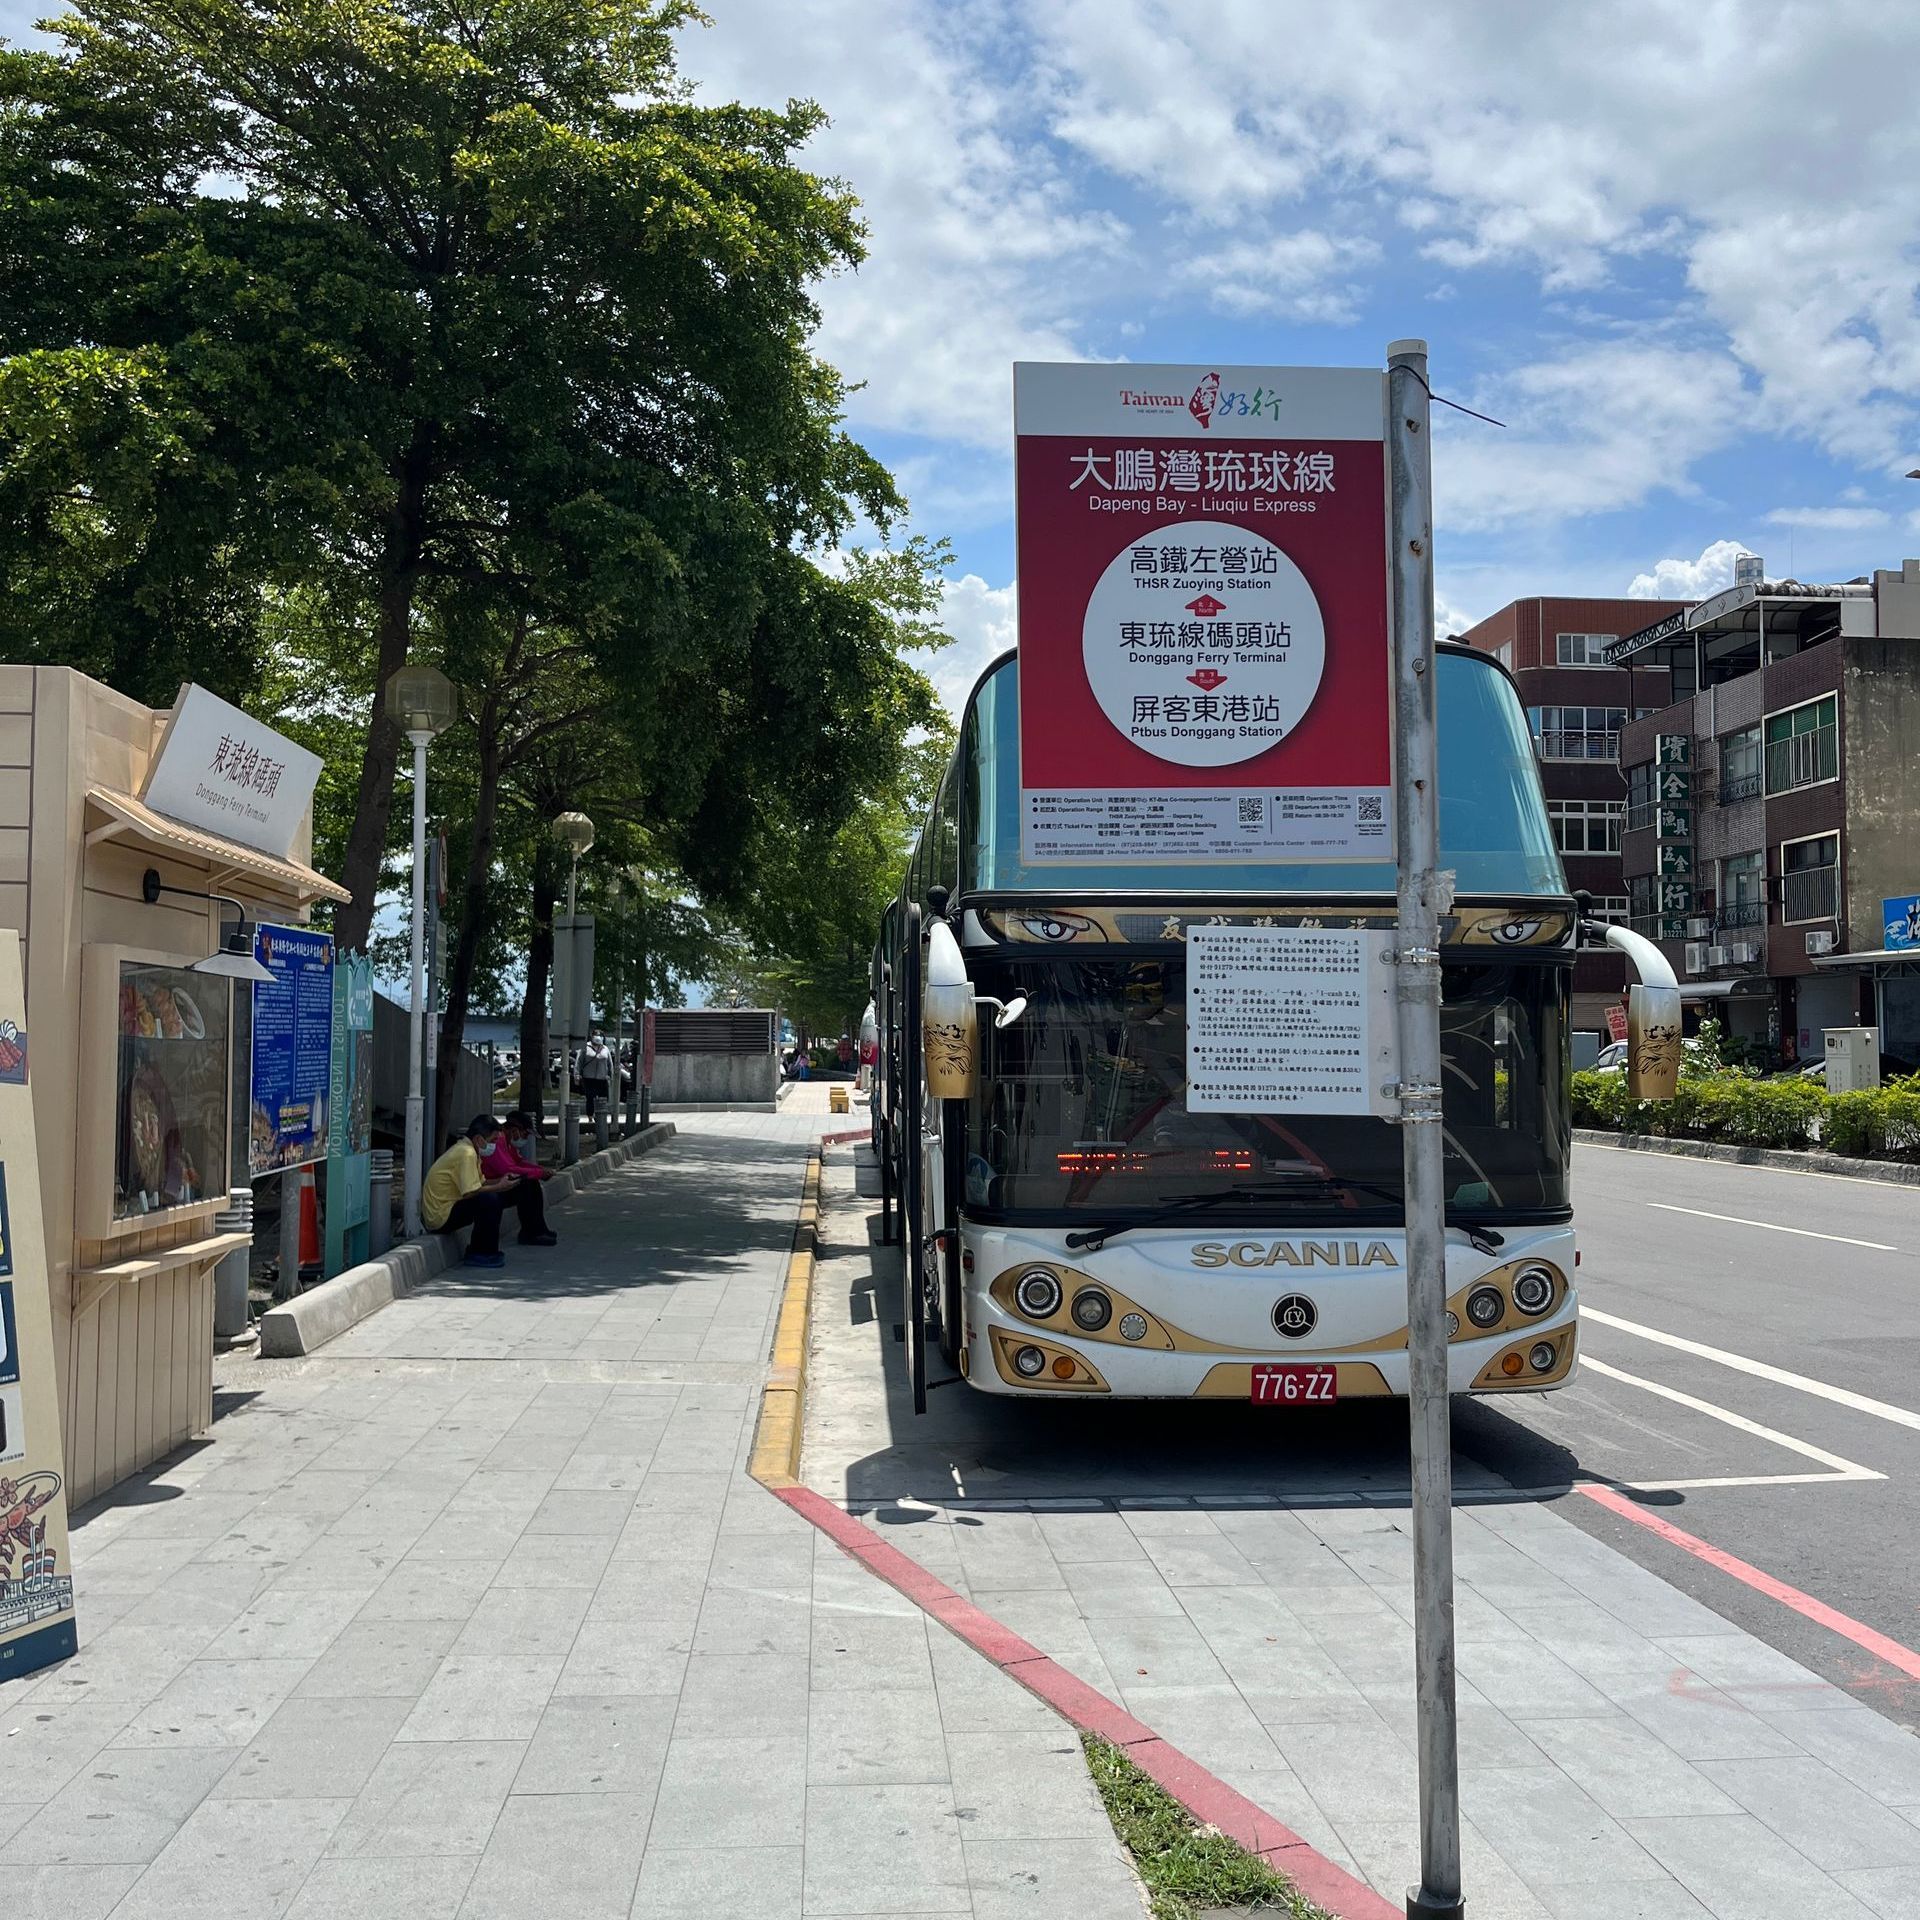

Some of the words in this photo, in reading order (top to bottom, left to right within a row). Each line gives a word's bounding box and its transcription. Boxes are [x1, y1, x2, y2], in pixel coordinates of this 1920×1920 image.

[1119, 390, 1185, 408] Taiwan
[1218, 386, 1282, 421] 好行
[1069, 448, 1336, 493] 大鵬灣琉球線
[1089, 496, 1151, 514] Dapeng
[1156, 497, 1187, 514] Bay
[1202, 497, 1248, 514] Liuqiu
[1254, 498, 1316, 514] Express
[1130, 545, 1278, 574] 高鐵左營站
[1134, 578, 1170, 589] THSR
[1173, 578, 1224, 593] Zuoying
[1227, 578, 1271, 590] Station
[1119, 620, 1291, 649] 東琉線碼頭站
[1129, 651, 1193, 665] Donggang
[1197, 651, 1230, 665] Ferry
[1233, 651, 1286, 663] Terminal
[1132, 695, 1280, 723] 屏客東港站
[1131, 726, 1167, 737] Ptbus
[1170, 726, 1235, 740] Donggang
[1239, 725, 1283, 737] Station
[207, 732, 286, 799] 東琉線碼頭
[195, 782, 228, 811] Donggang
[229, 795, 244, 817] Ferry
[244, 802, 271, 824] Terminal
[1191, 1241, 1400, 1267] SCANIA
[1255, 1374, 1334, 1400] 776-ZZ
